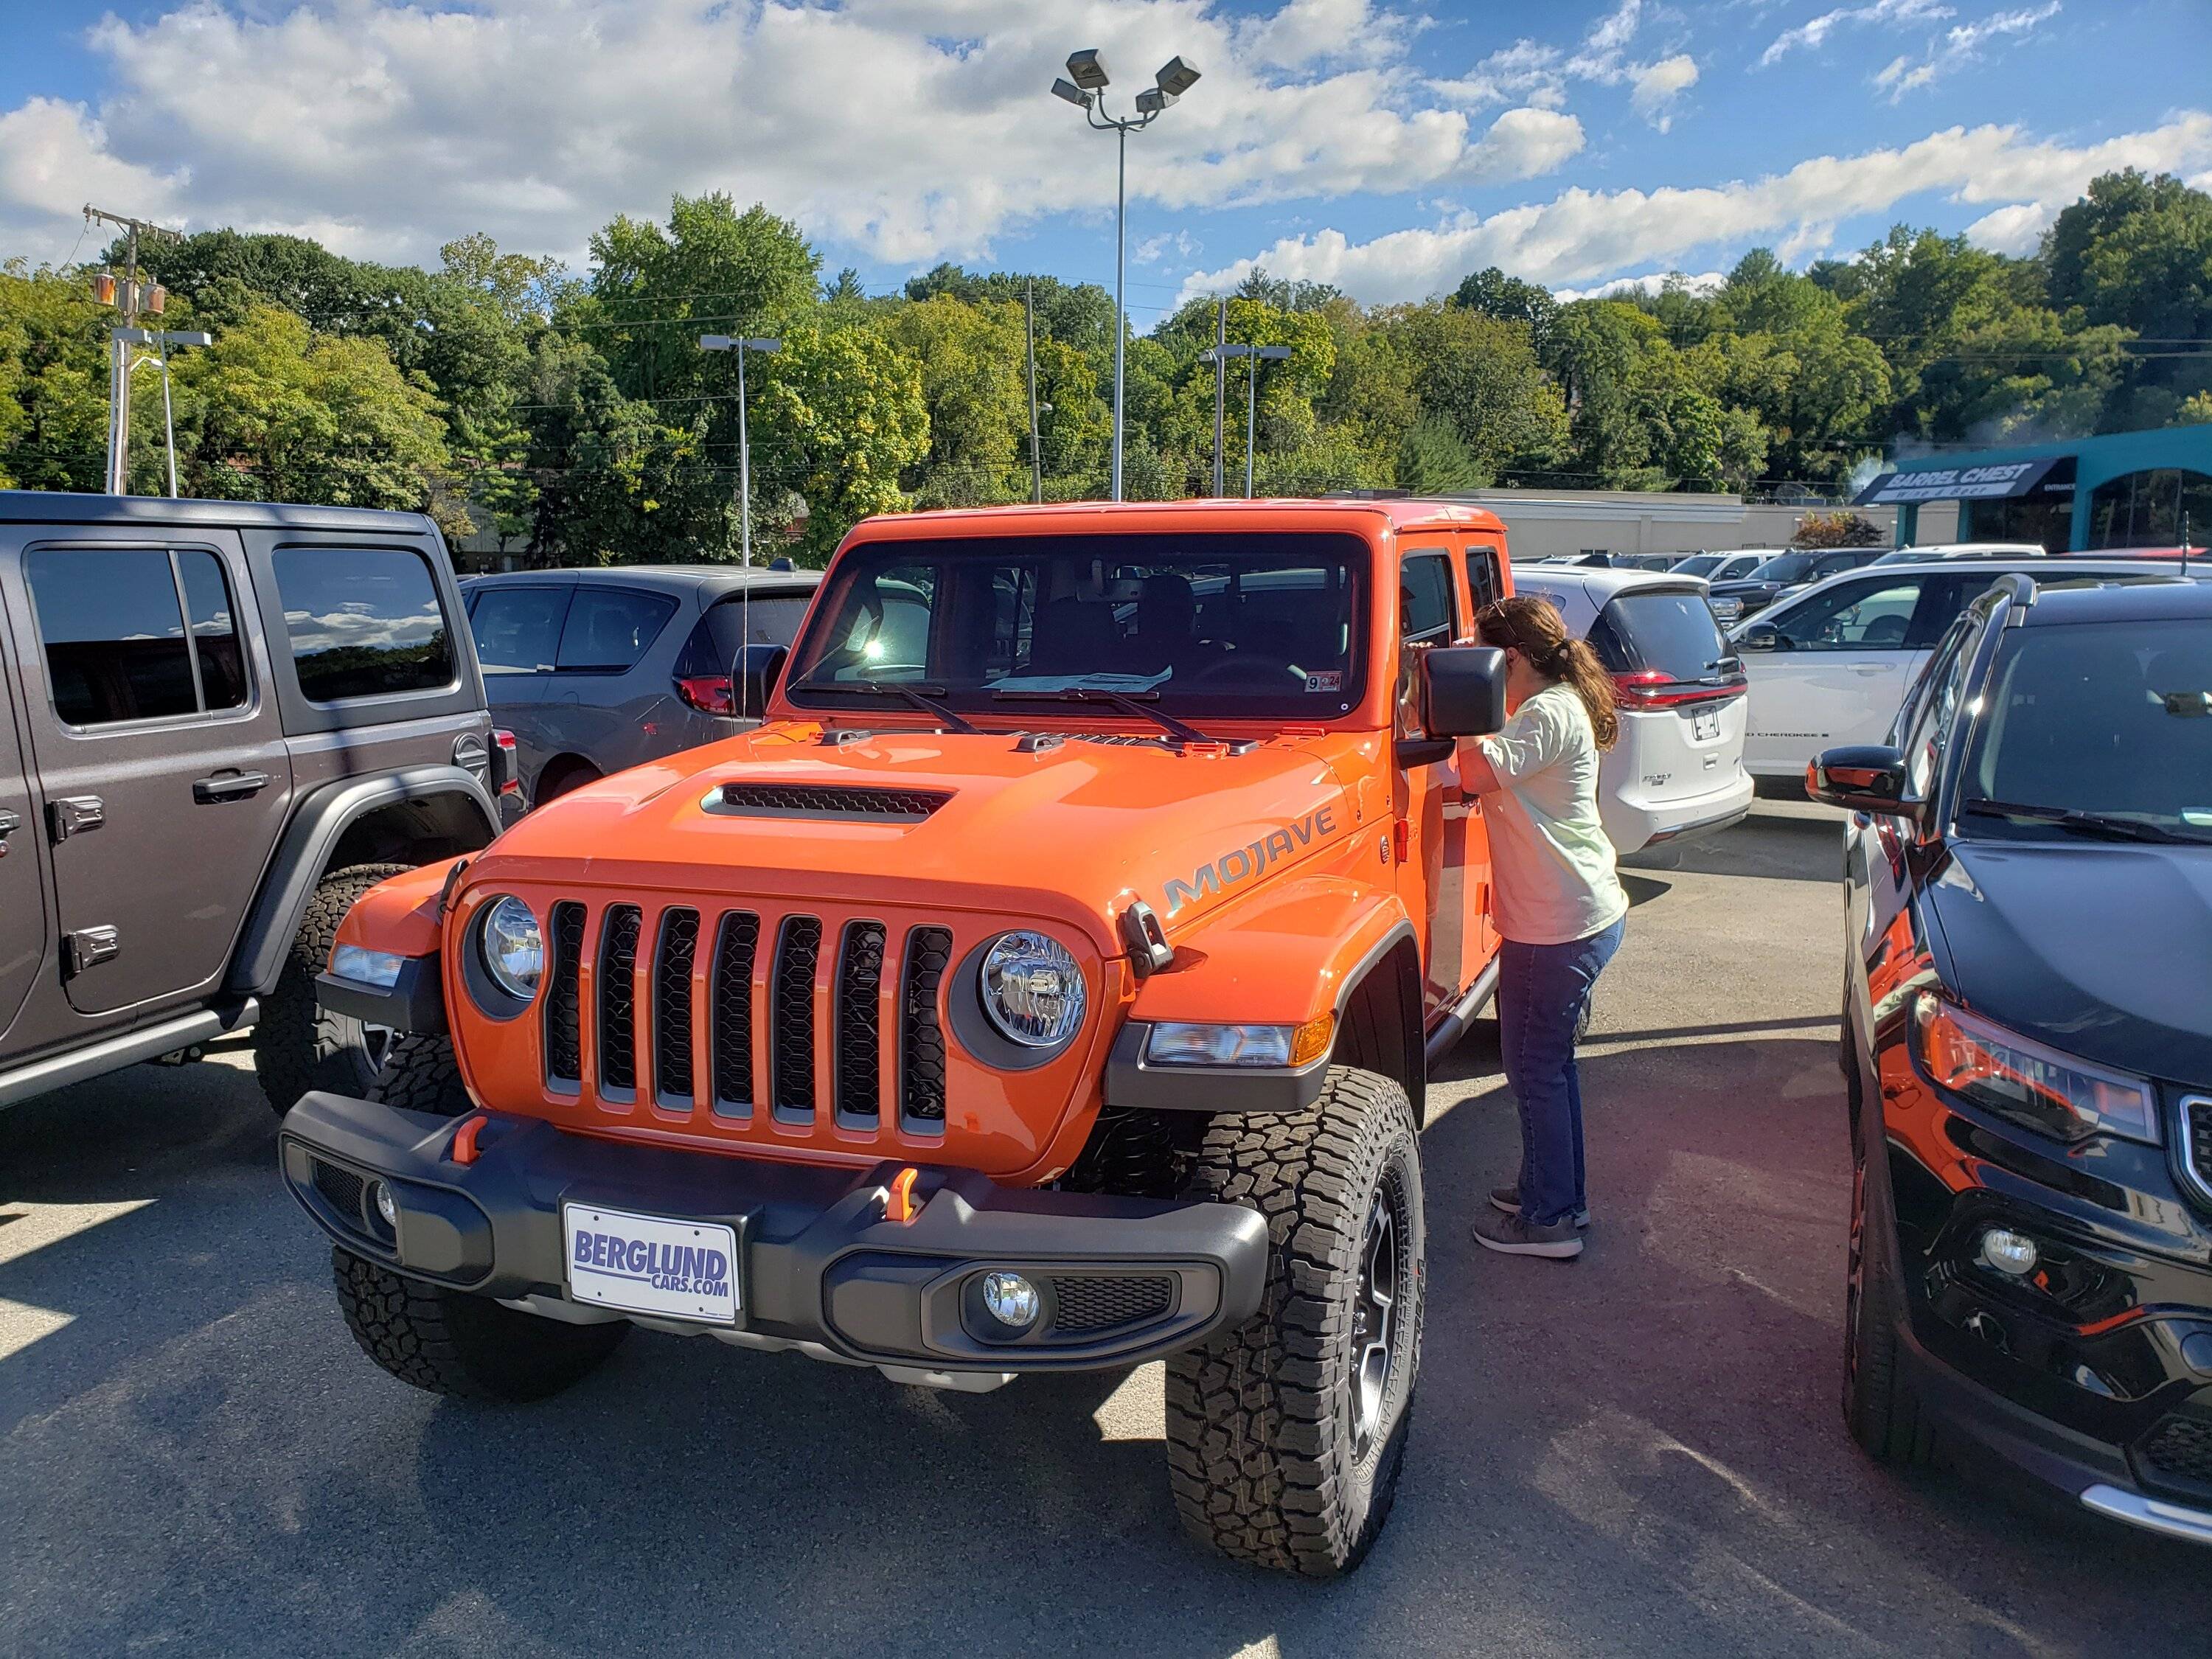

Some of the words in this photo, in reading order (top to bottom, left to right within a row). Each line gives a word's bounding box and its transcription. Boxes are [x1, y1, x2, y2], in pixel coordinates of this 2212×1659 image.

[1886, 470, 1958, 487] BARREL
[1961, 463, 2033, 482] CHEST
[1309, 677, 1318, 689] 9
[1330, 676, 1339, 685] 24
[1162, 806, 1337, 911] MOJAVE
[574, 1229, 728, 1281] BERGLUND
[650, 1273, 728, 1297] CARS.COM
